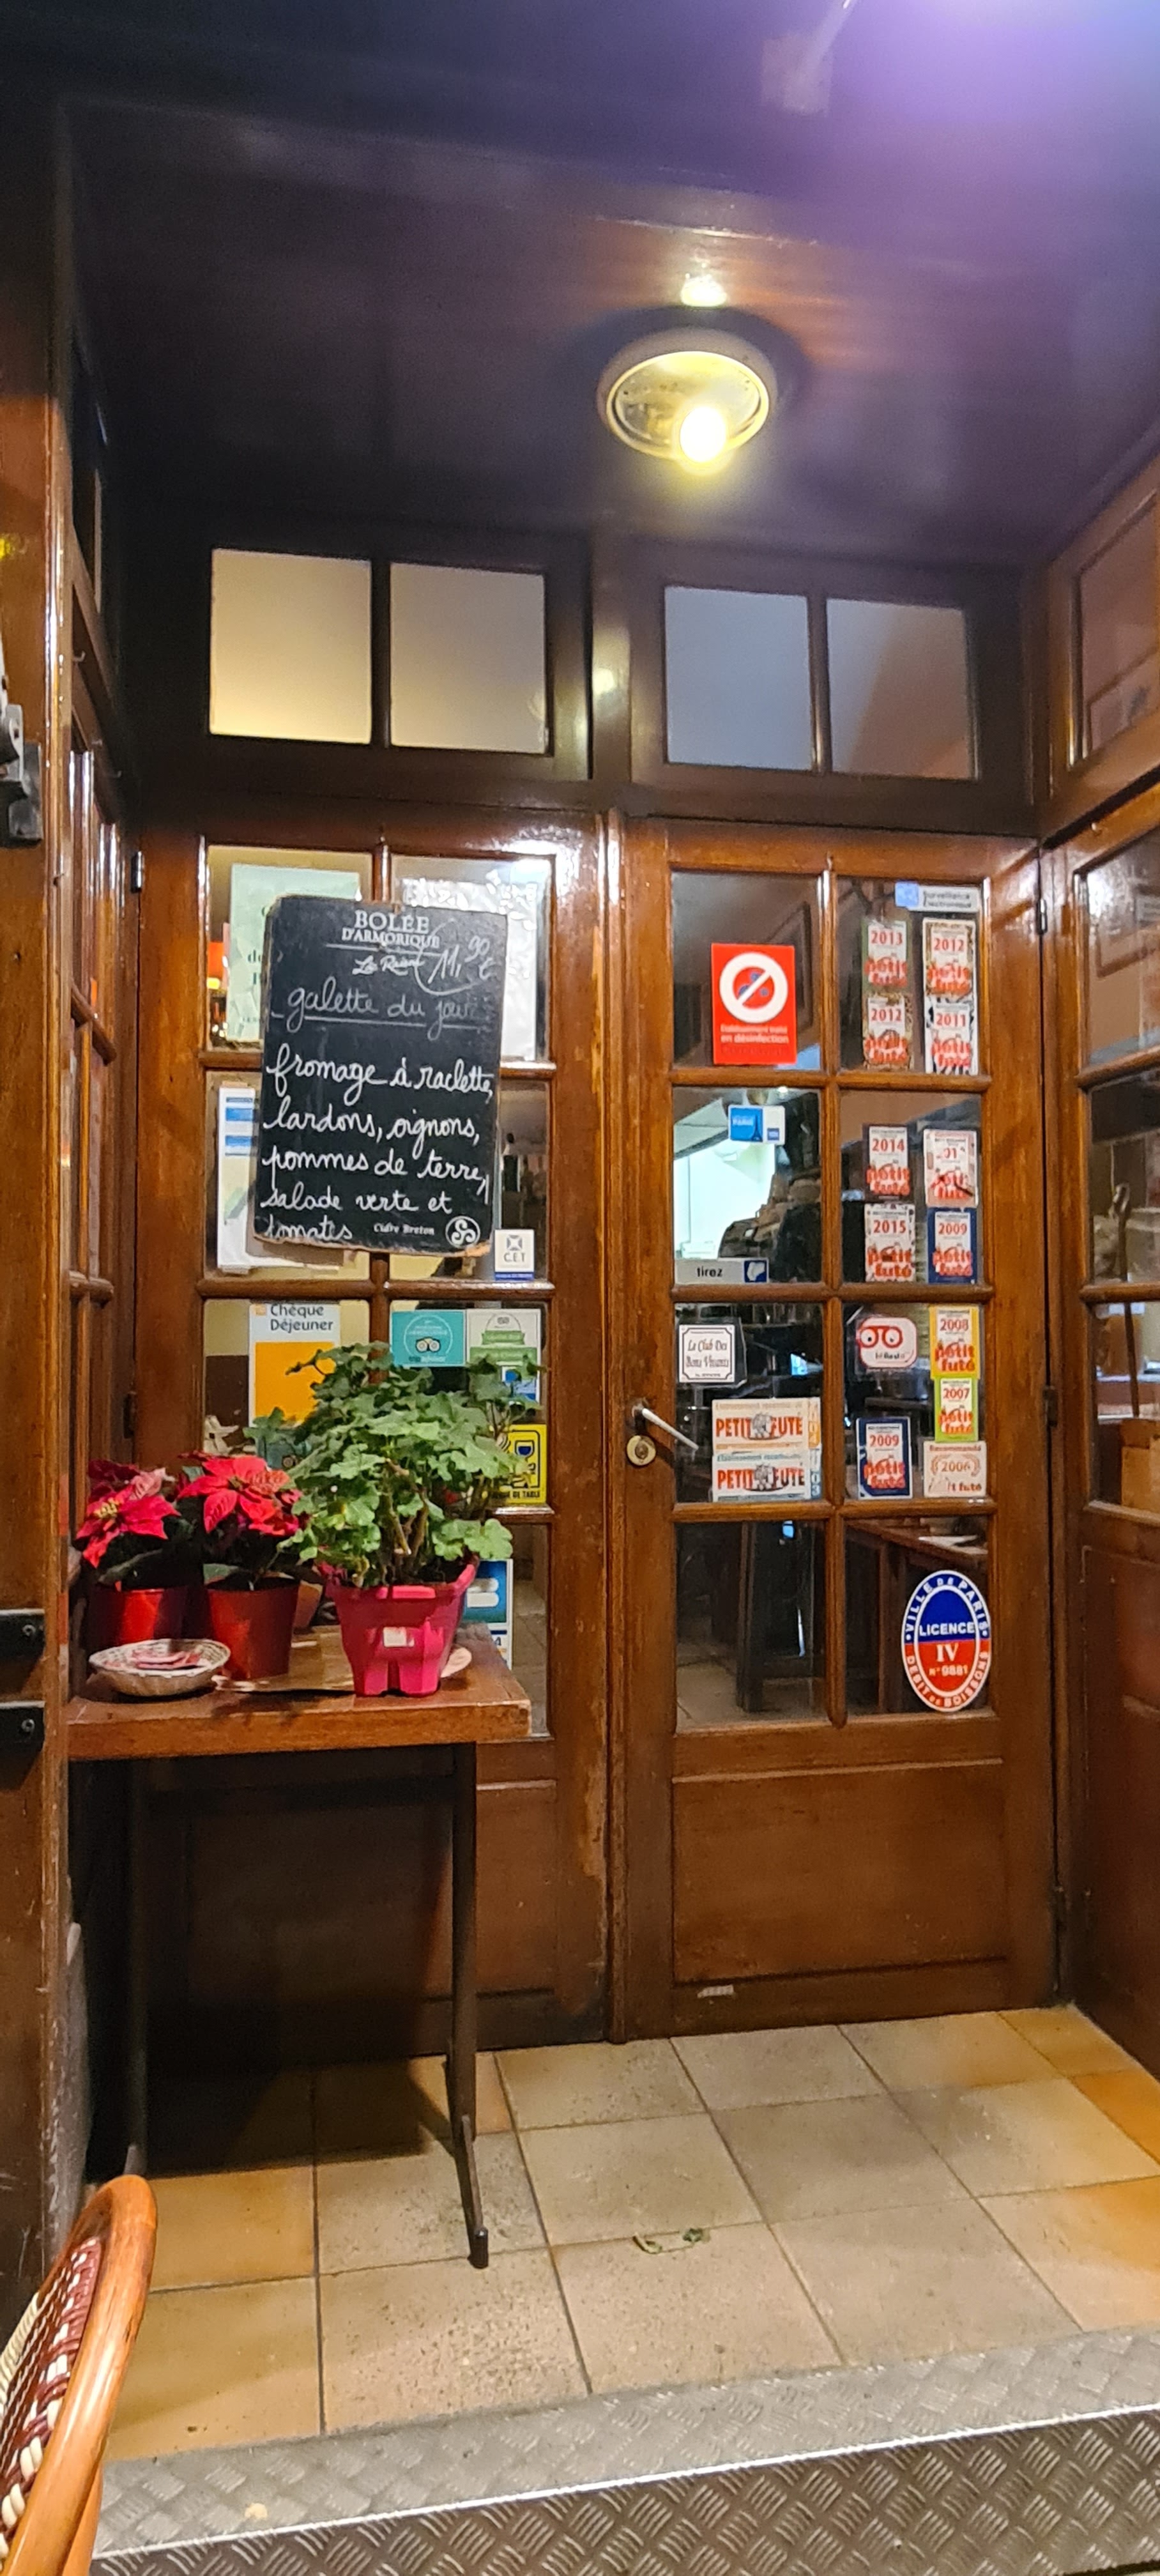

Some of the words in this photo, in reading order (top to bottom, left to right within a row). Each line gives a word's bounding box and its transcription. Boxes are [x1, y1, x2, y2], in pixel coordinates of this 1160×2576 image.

[341, 927, 440, 948] D'ARMORIQUE
[871, 930, 903, 946] 2013
[933, 937, 965, 951] 2012
[286, 976, 379, 1033] galette
[387, 993, 425, 1018] du
[871, 1008, 902, 1022] 2012
[936, 1013, 966, 1027] 2011
[734, 1033, 790, 1043] désinfection
[266, 1043, 387, 1106] fromage
[390, 1057, 412, 1087] à
[414, 1058, 494, 1104] raclette,
[263, 1095, 383, 1143] lardons,
[386, 1108, 480, 1160] oignons,
[871, 1138, 905, 1153] 2014
[262, 1145, 369, 1190] pommes
[374, 1148, 408, 1176] de
[260, 1181, 344, 1211] salade
[356, 1190, 419, 1211] verte
[427, 1191, 452, 1214] et
[264, 1213, 353, 1240] tomates
[374, 1223, 399, 1234] Cidre
[403, 1224, 434, 1236] Breton
[873, 1220, 906, 1234] 2015
[939, 1223, 967, 1235] 2009
[697, 1266, 723, 1278] tirez
[874, 1262, 912, 1277] futé
[270, 1303, 324, 1318] Chèque
[270, 1318, 333, 1334] Déjeuner
[940, 1318, 969, 1331] 2008
[935, 1342, 975, 1361] petit
[942, 1358, 975, 1372] futé
[943, 1388, 970, 1399] 2007
[939, 1409, 973, 1425] petit
[715, 1418, 751, 1437] PETIT
[870, 1435, 899, 1447] 2009
[942, 1460, 970, 1472] 2006
[717, 1469, 753, 1490] PETIT
[905, 1582, 934, 1632] VILLE
[936, 1577, 954, 1586] DE
[958, 1579, 988, 1630] PARIS
[919, 1621, 975, 1636] LICENCE
[936, 1643, 959, 1662] IV
[906, 1655, 931, 1694] DEBIT
[943, 1651, 989, 1708] BOISSONS
